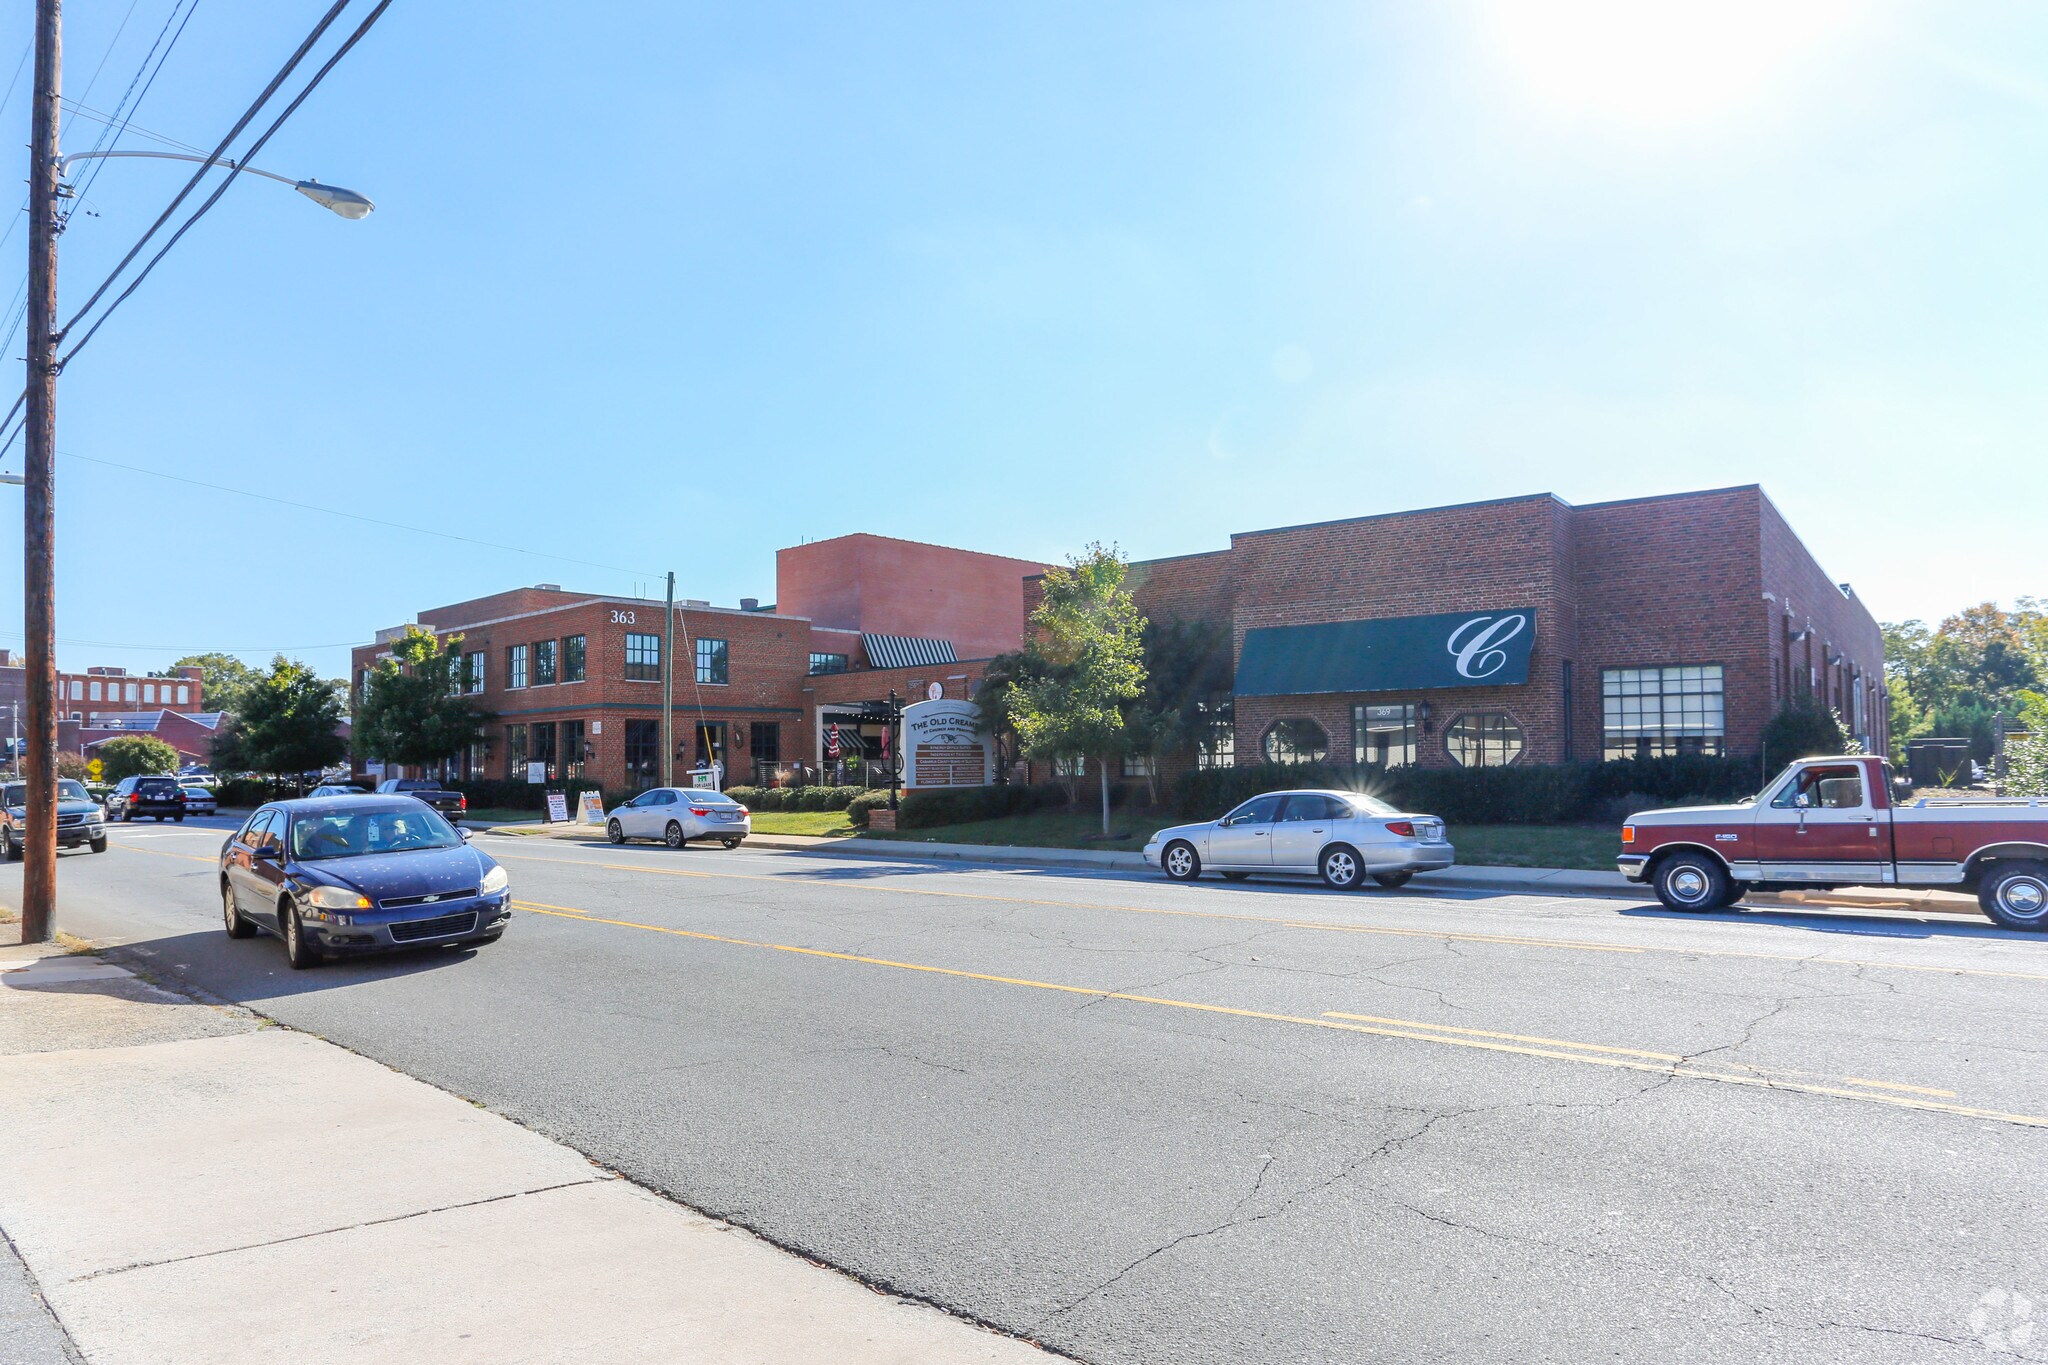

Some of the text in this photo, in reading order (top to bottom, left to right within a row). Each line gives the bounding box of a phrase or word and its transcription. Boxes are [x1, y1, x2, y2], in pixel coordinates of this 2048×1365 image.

[610, 609, 635, 624] 363
[1446, 614, 1526, 679] C
[1377, 707, 1391, 716] 369
[911, 720, 928, 731] THE
[930, 718, 947, 726] OLD
